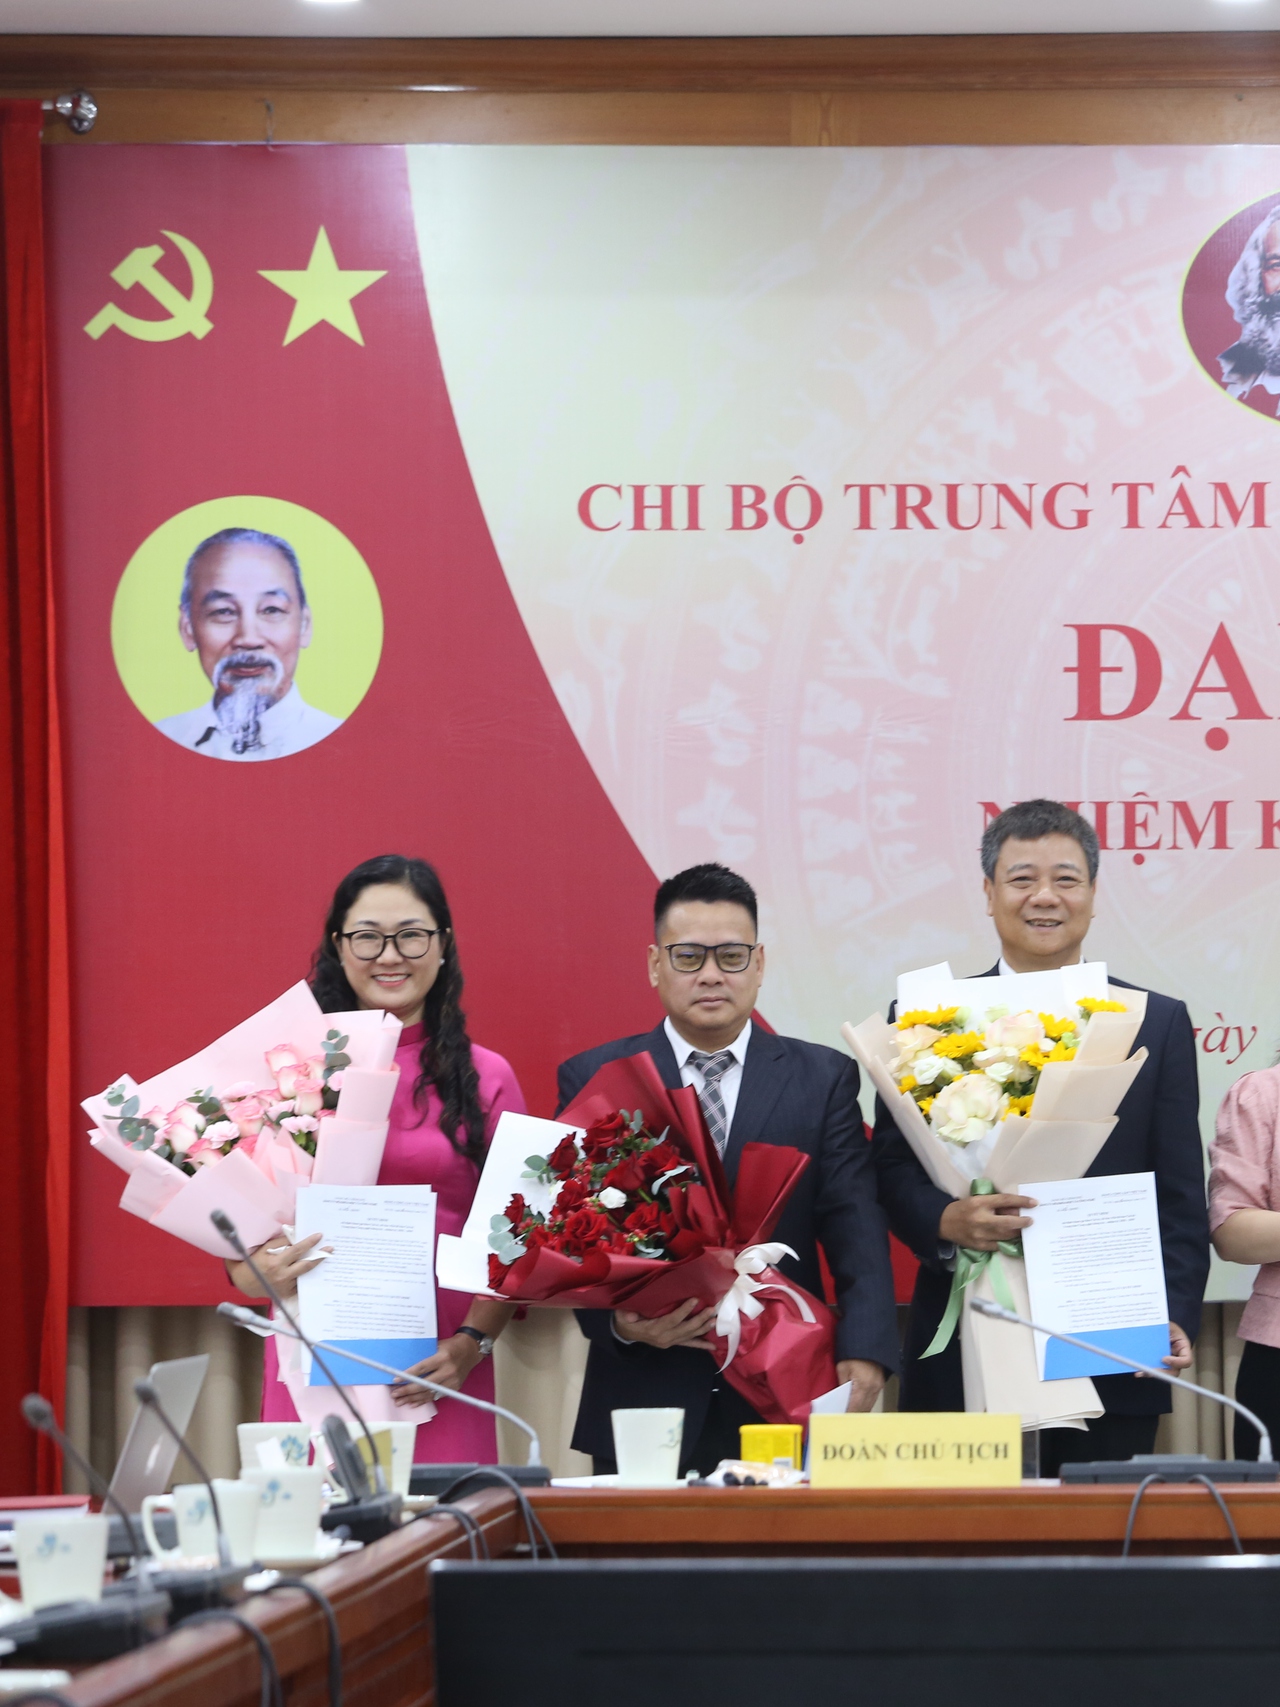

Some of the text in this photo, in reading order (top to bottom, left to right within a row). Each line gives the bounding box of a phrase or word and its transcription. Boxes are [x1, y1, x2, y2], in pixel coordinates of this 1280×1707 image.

[577, 484, 706, 531] CHI
[725, 475, 823, 545] BỘ
[844, 481, 1094, 531] TRUNG
[1112, 465, 1273, 529] TÂM
[976, 791, 1234, 866] IỆM
[822, 1437, 1010, 1465] ĐOÀN CHỦ TỊCH
